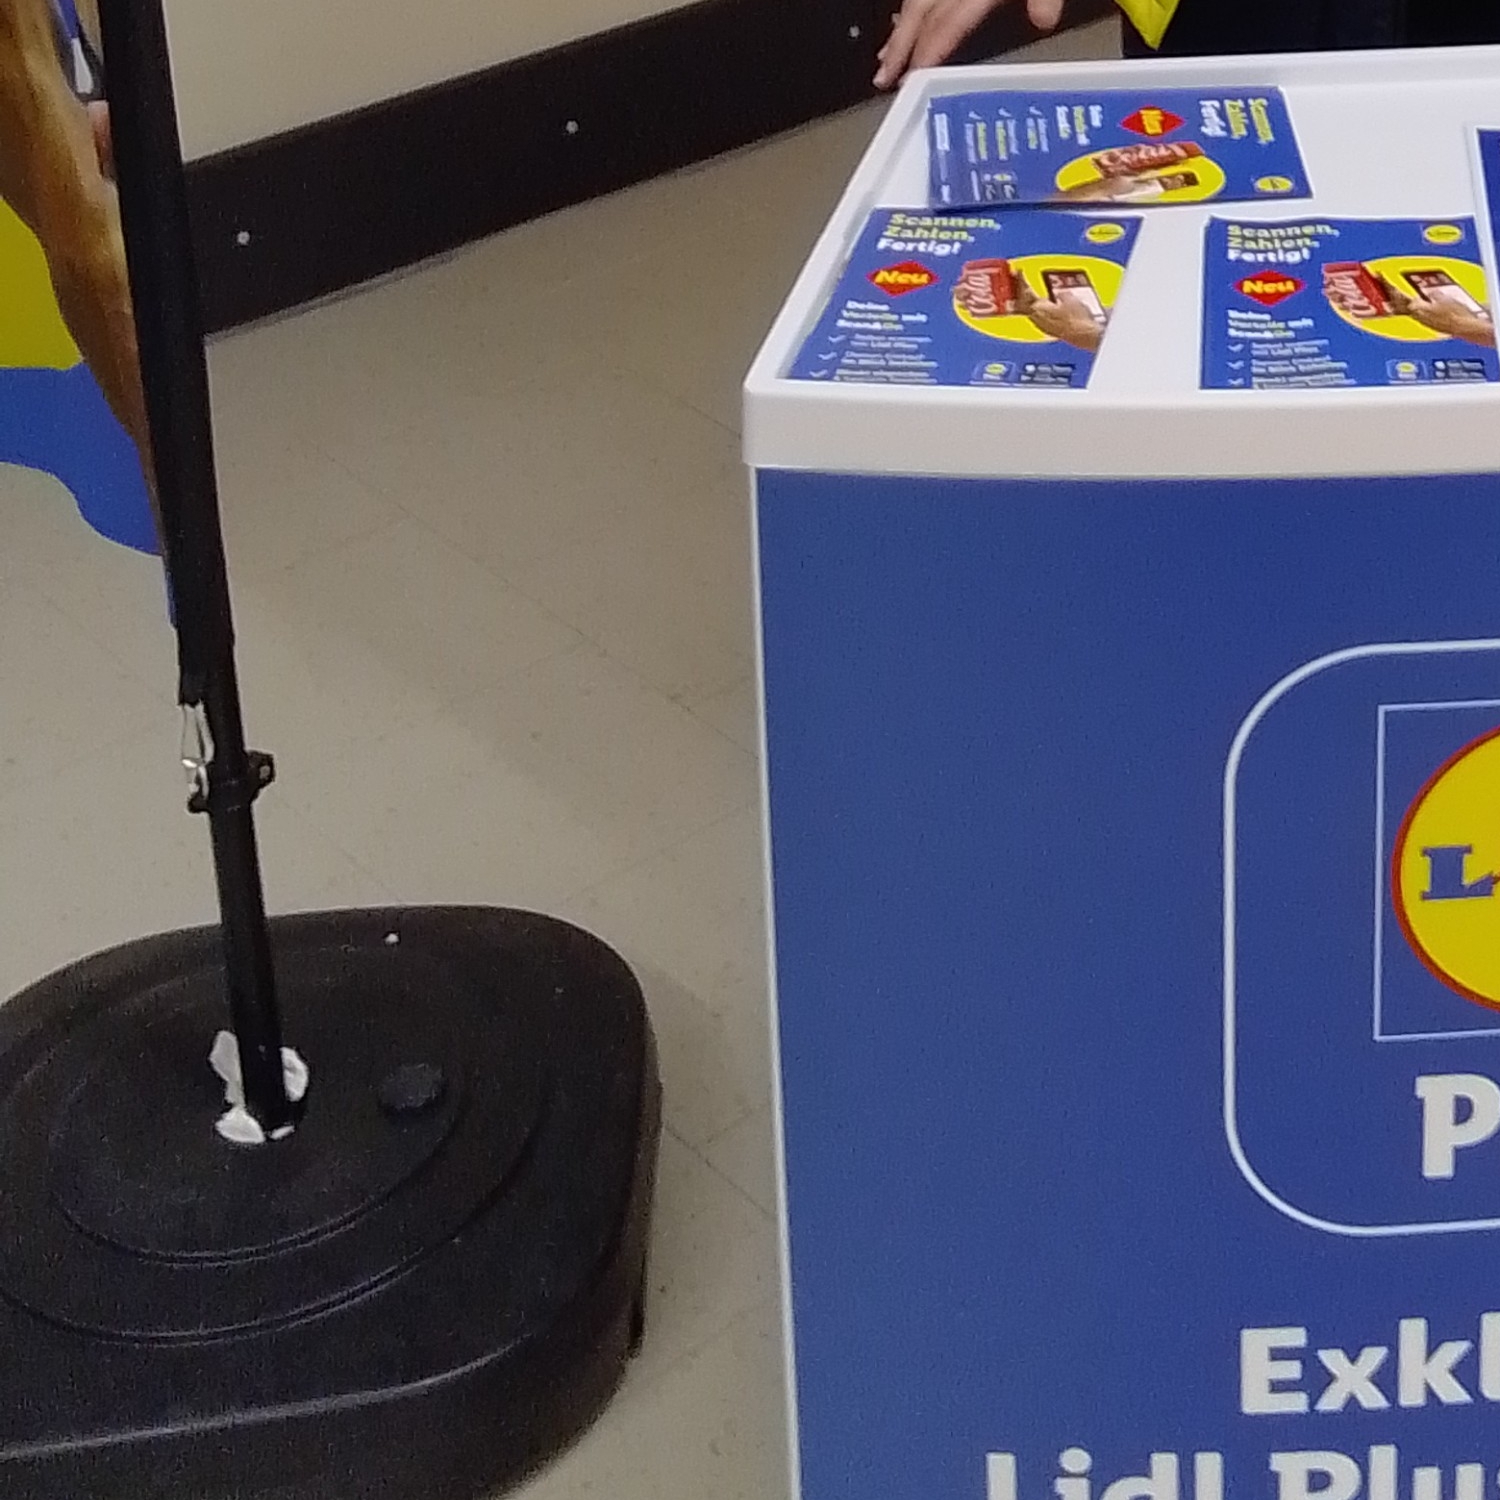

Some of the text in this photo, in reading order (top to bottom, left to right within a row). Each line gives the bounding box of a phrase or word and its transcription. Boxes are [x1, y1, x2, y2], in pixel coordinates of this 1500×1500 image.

[890, 213, 1001, 231] Scannen,
[882, 225, 975, 242] Zahlen,
[1227, 224, 1340, 238] Scannen,
[876, 237, 961, 256] Fertig!
[1227, 237, 1320, 250] Zahlen,
[874, 270, 931, 285] Neu
[1242, 279, 1296, 295] Neu
